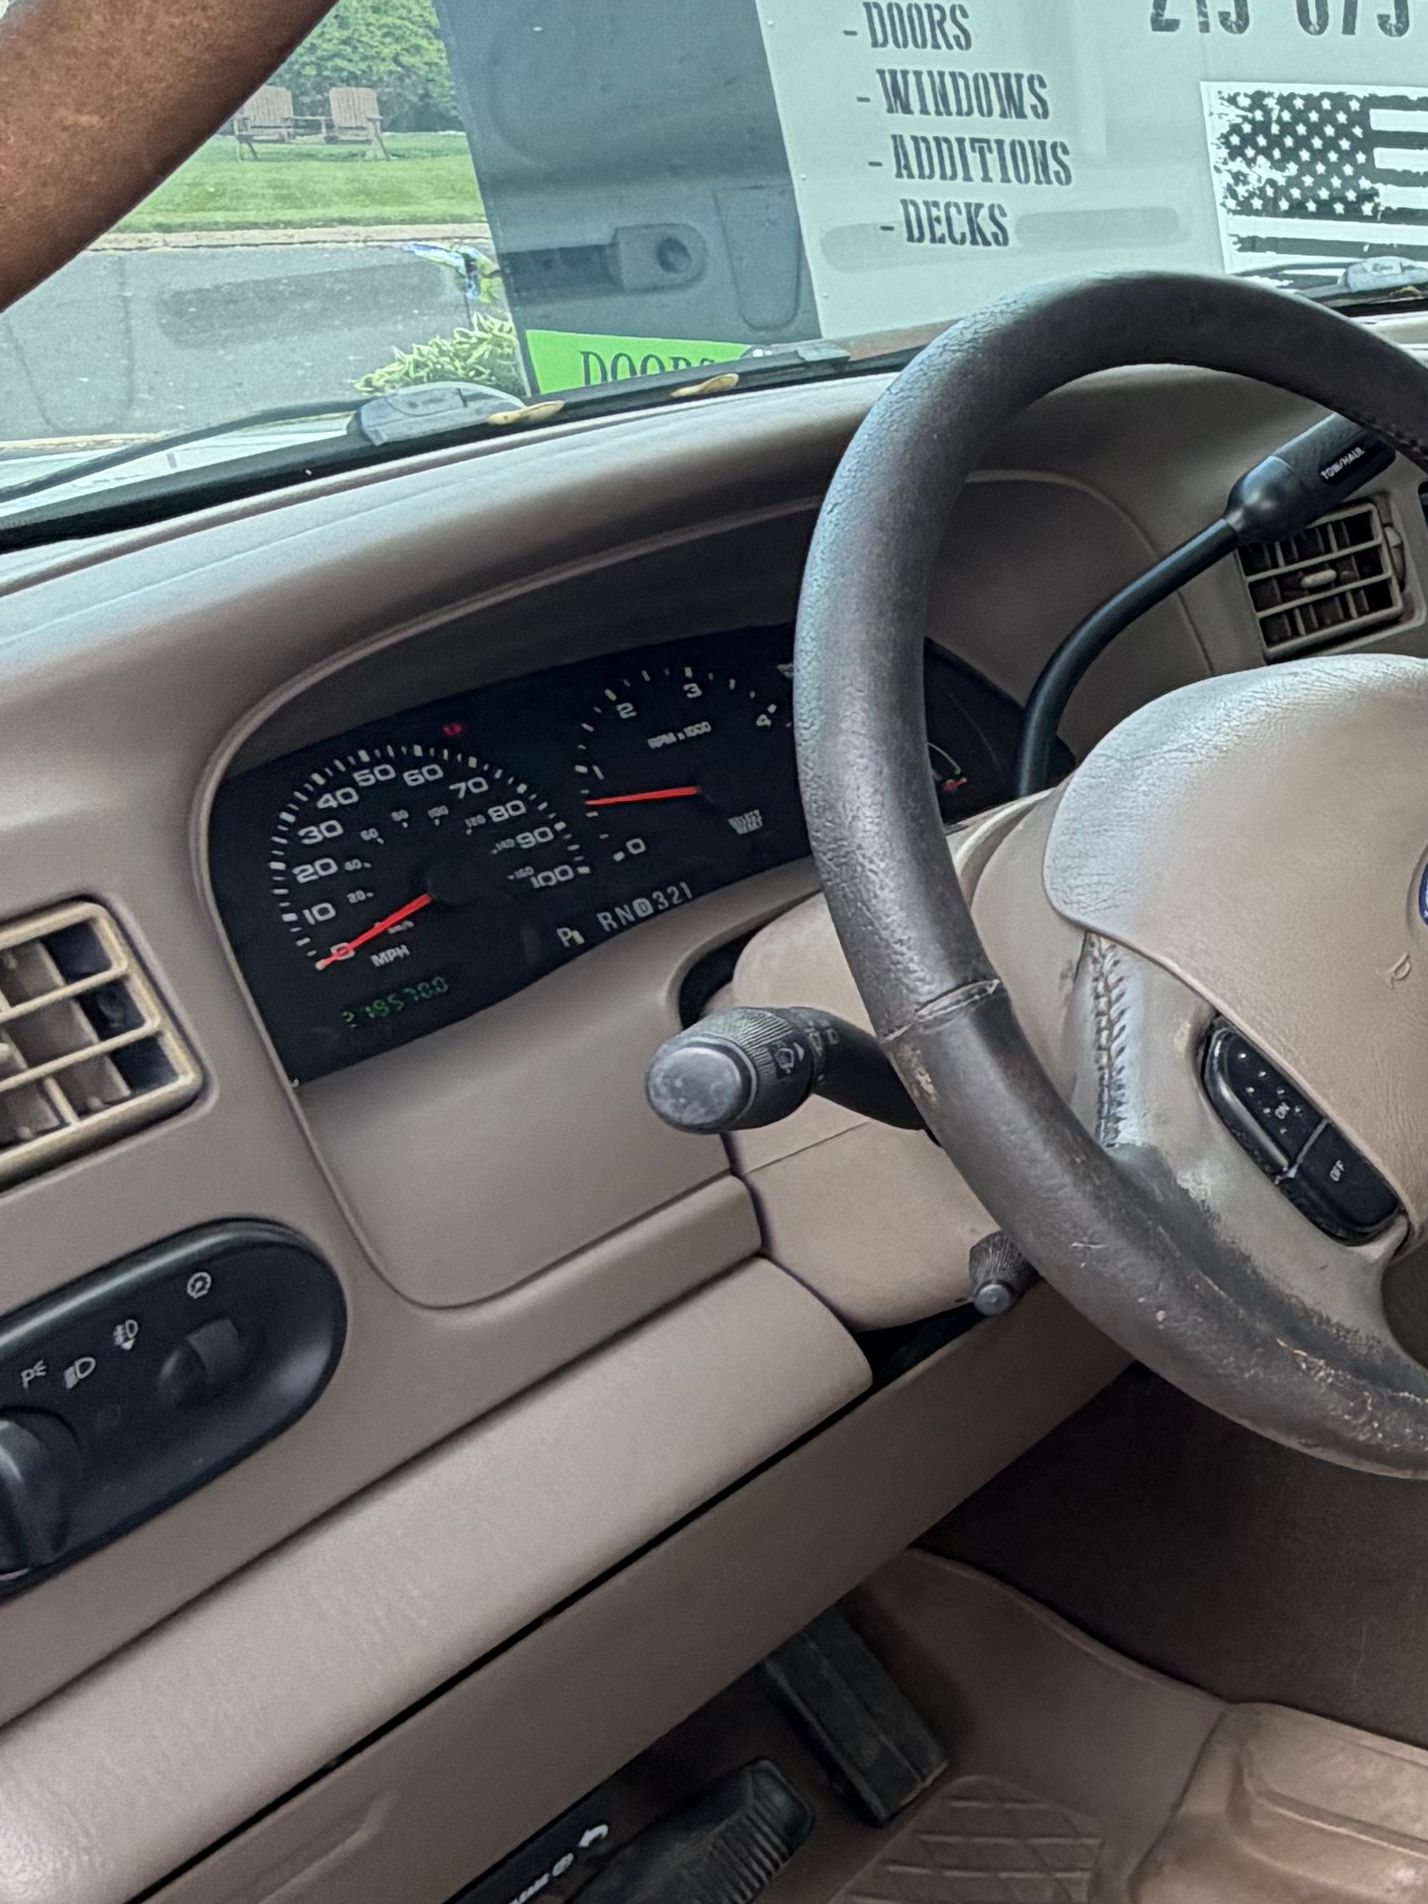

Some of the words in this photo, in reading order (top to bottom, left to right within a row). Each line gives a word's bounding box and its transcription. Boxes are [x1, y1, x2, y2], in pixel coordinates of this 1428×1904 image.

[682, 682, 703, 699] 3
[616, 701, 638, 720] 2
[352, 763, 397, 787] 50
[402, 763, 444, 787] 60
[316, 786, 360, 810] 40
[448, 776, 489, 799] 70
[487, 799, 527, 823] 80
[297, 818, 344, 846] 30
[514, 825, 555, 849] 90
[292, 857, 339, 884] 20
[530, 864, 575, 889] 100
[302, 901, 337, 926] 10
[370, 943, 411, 968] MPH
[1328, 1159, 1346, 1183] OFF
